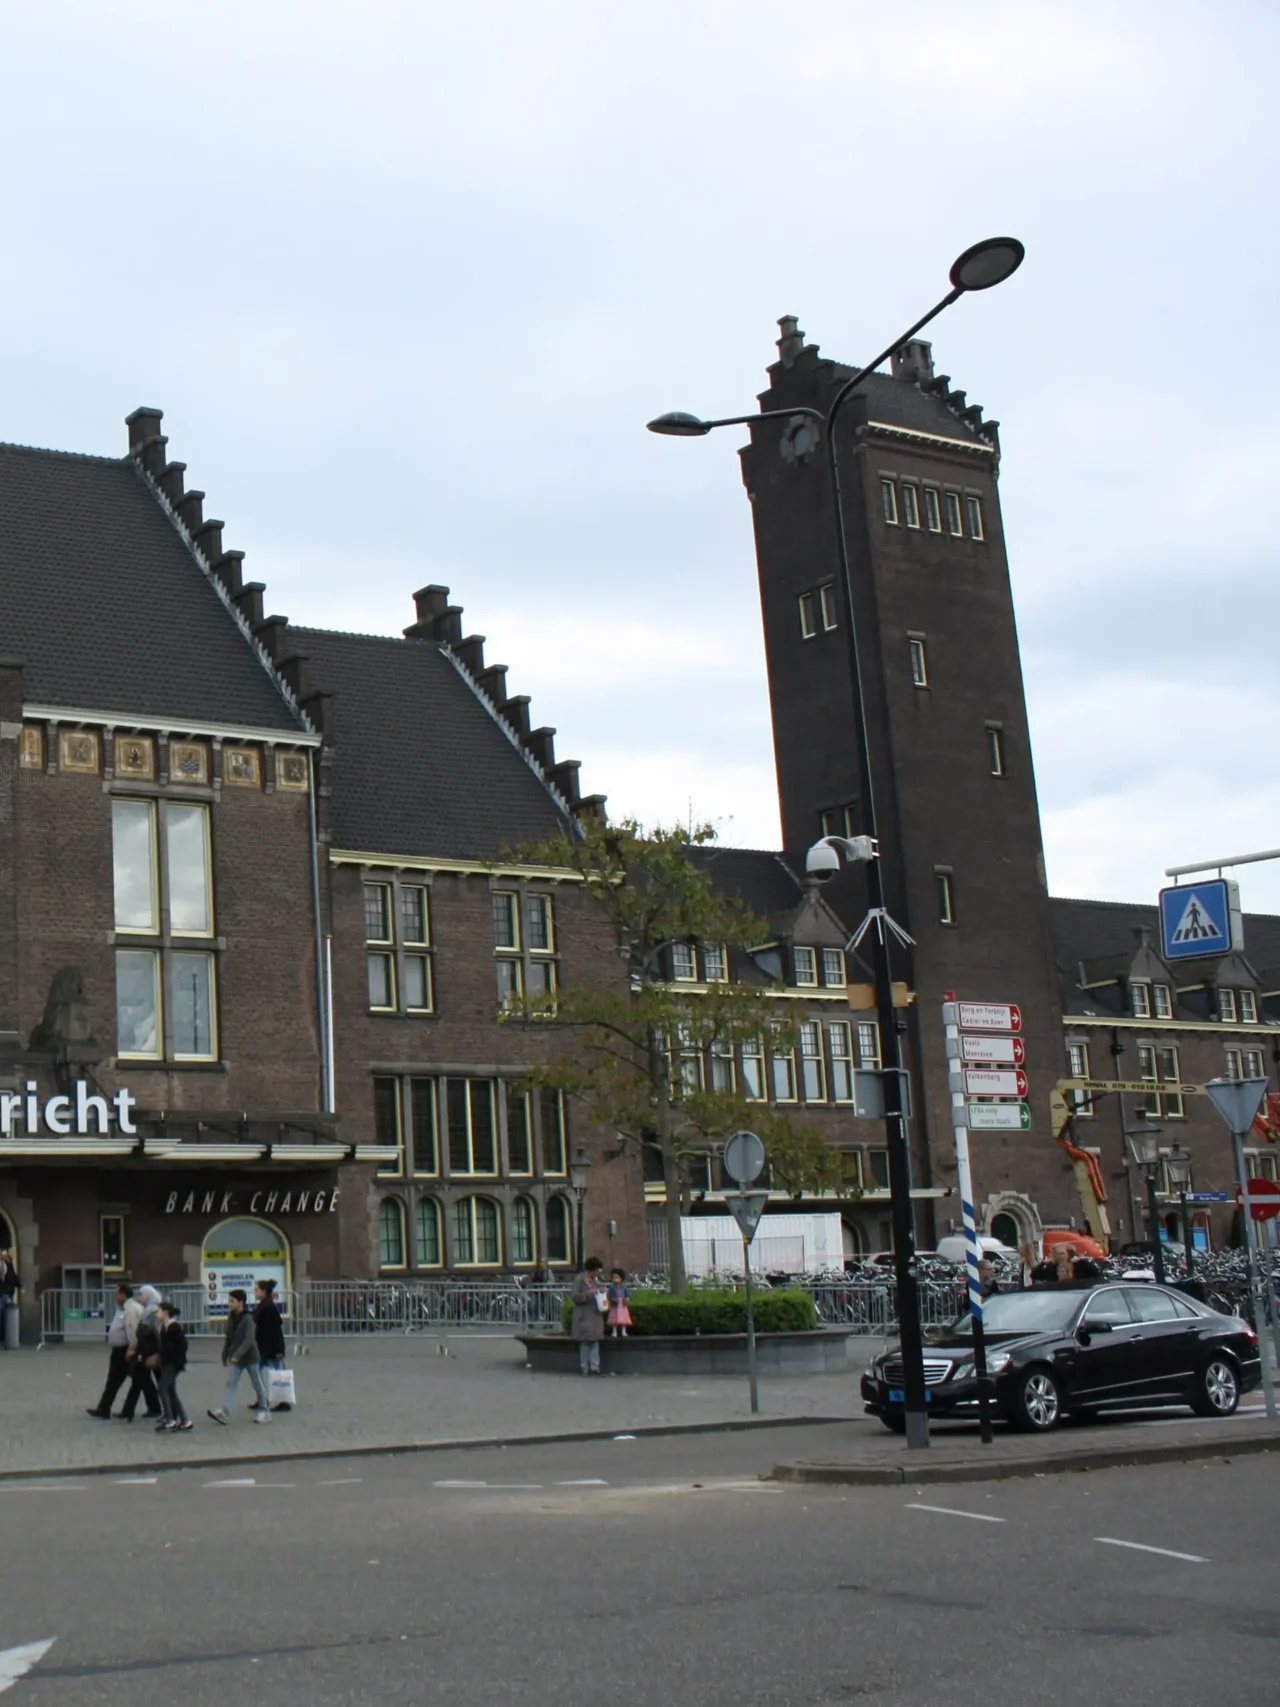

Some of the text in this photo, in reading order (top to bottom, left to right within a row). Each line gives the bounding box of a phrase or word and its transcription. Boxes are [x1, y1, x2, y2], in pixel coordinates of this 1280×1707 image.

[961, 1006, 975, 1015] Berg
[968, 1073, 1000, 1082] Valkenburg
[165, 1187, 340, 1213] BANK CHANGE
